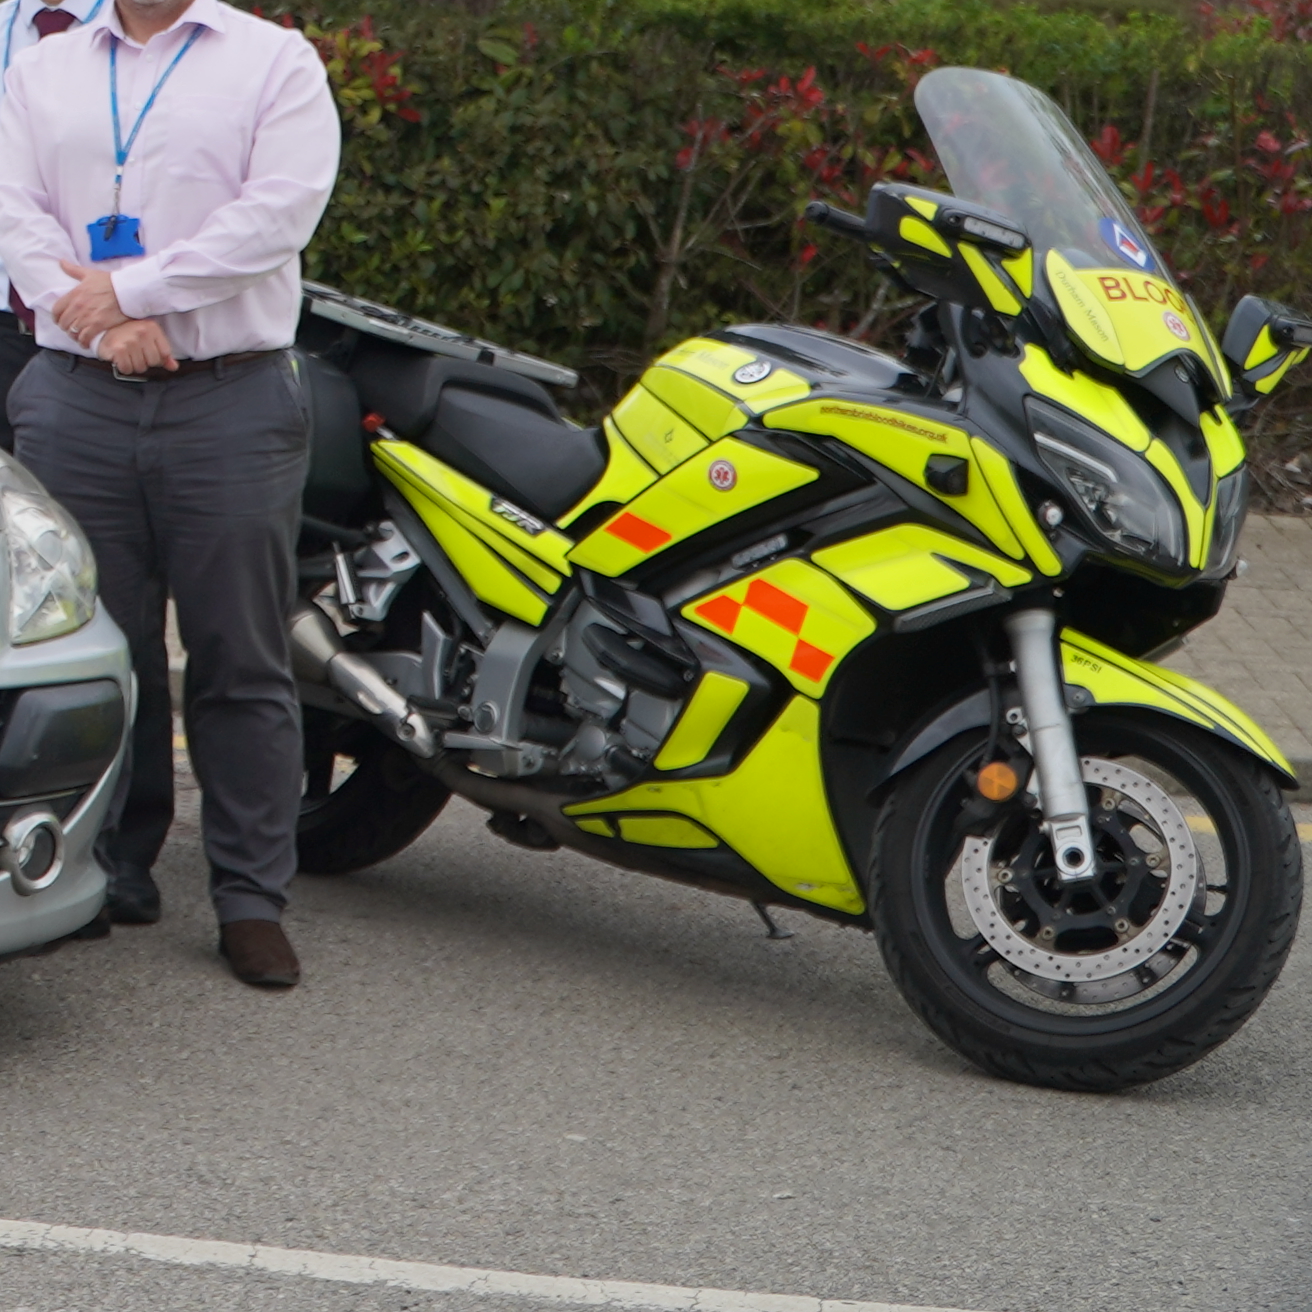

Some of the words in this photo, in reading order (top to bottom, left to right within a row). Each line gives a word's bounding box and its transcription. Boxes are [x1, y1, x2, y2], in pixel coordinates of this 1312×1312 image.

[1055, 270, 1086, 308] Durham
[1085, 308, 1110, 343] Mason
[1097, 276, 1190, 319] BLOO
